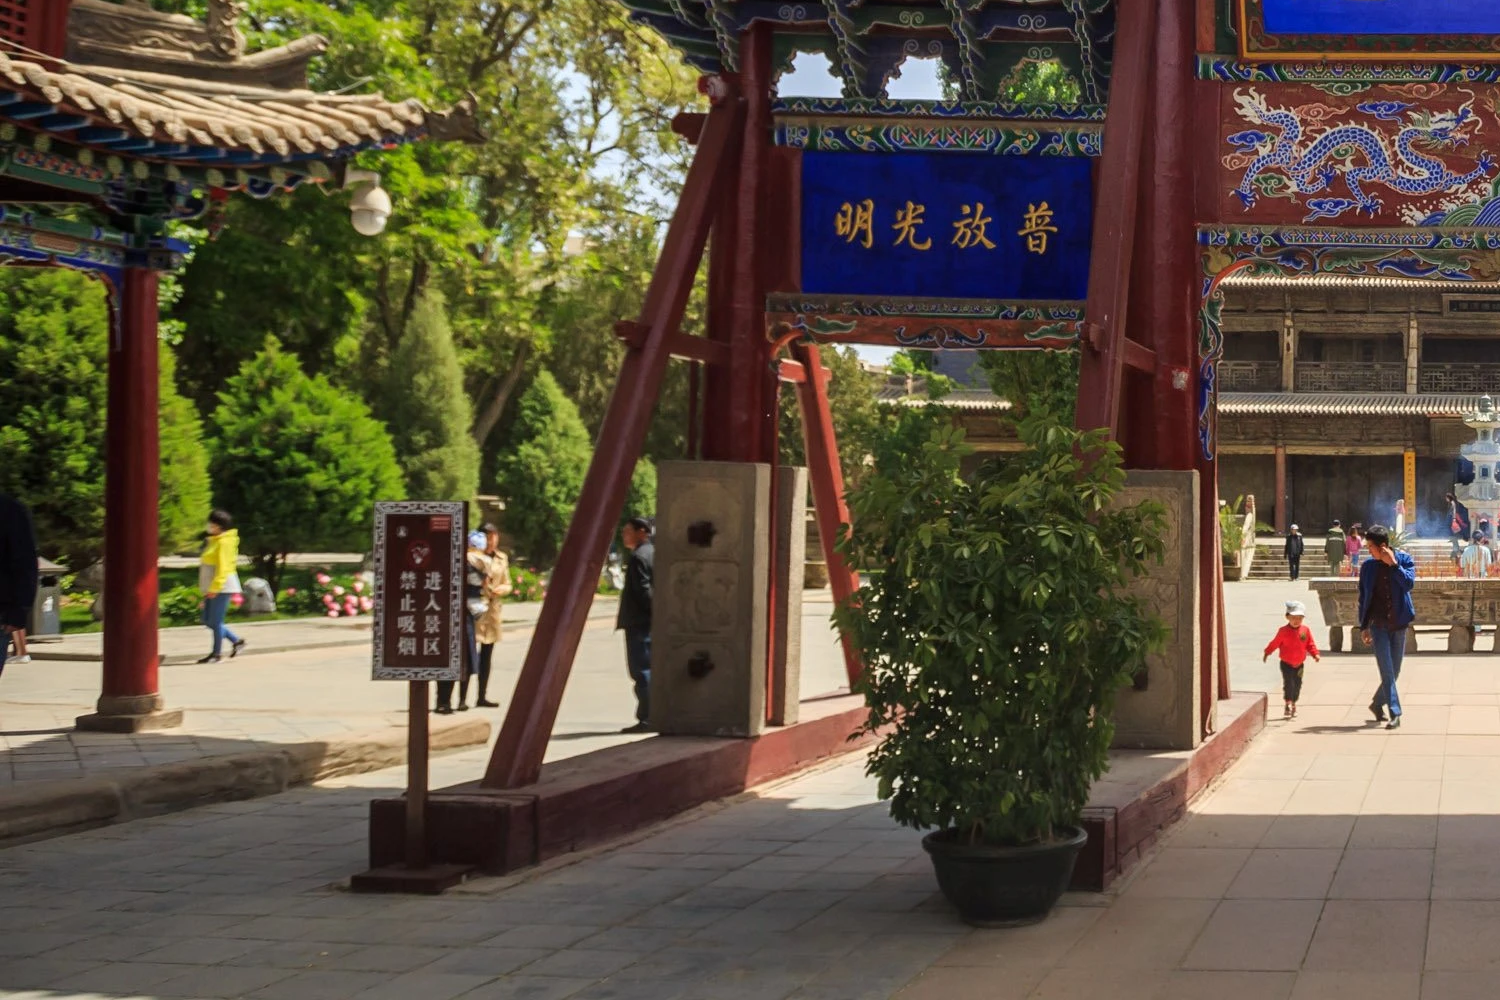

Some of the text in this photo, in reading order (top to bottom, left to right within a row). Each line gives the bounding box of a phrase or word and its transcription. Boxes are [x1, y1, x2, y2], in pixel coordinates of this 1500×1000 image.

[396, 571, 417, 657] 禁止吸烟
[423, 571, 443, 657] 进入景区
